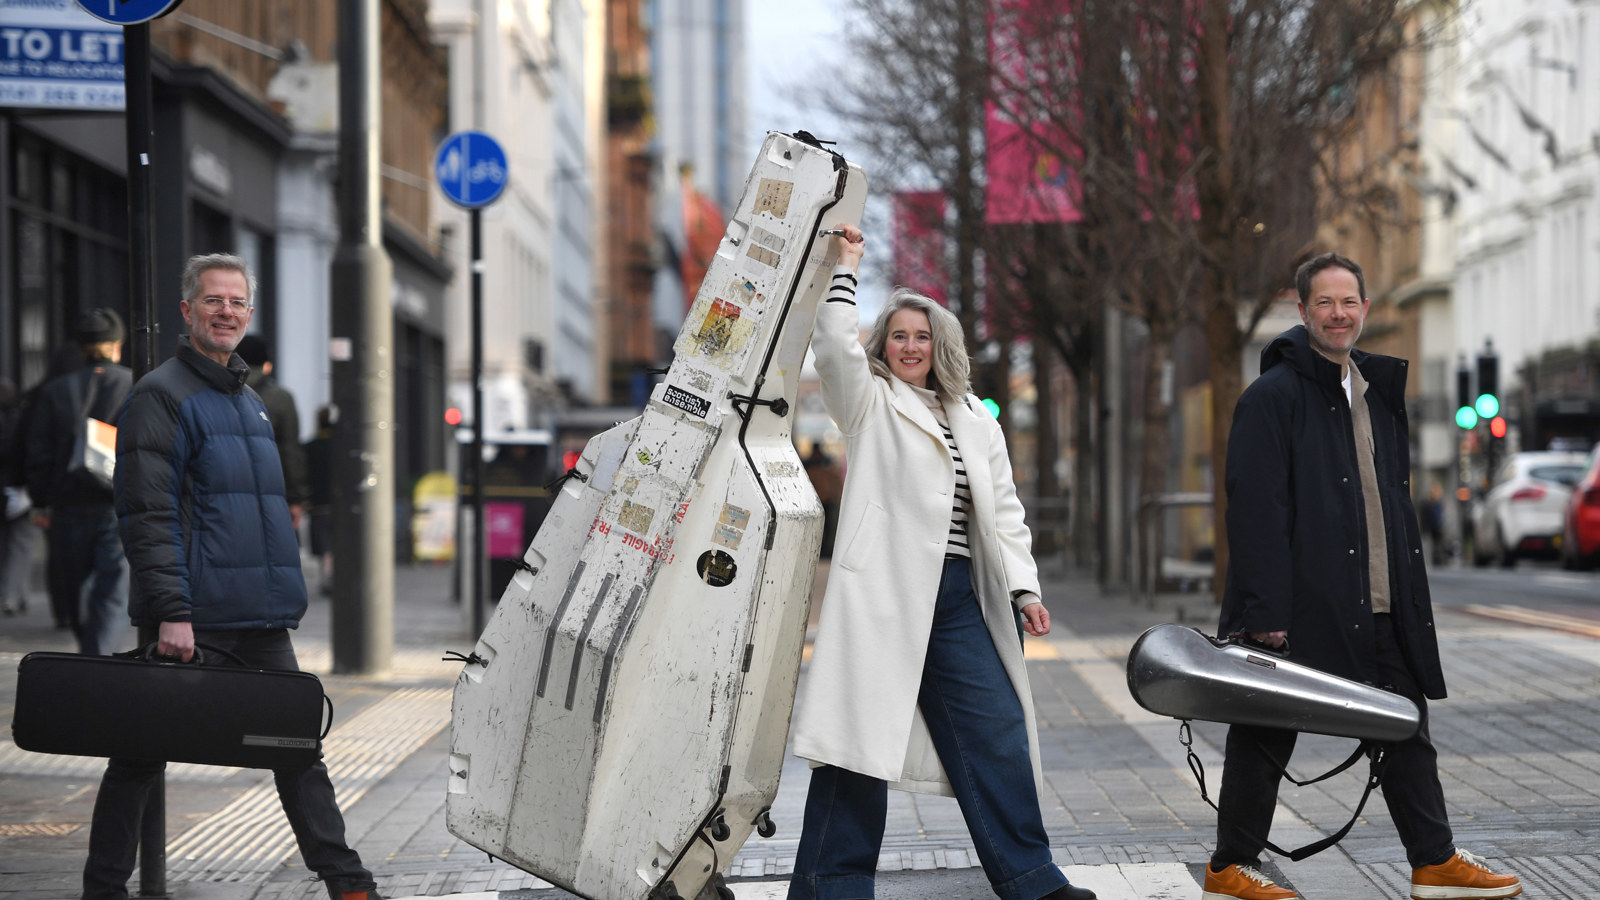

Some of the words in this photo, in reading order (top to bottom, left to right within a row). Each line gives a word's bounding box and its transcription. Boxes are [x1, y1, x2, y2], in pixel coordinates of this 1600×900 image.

[2, 29, 53, 60] TO
[60, 31, 124, 63] LET
[47, 61, 124, 80] RELOCATIO
[664, 394, 706, 417] ensemble
[667, 388, 701, 407] scottish
